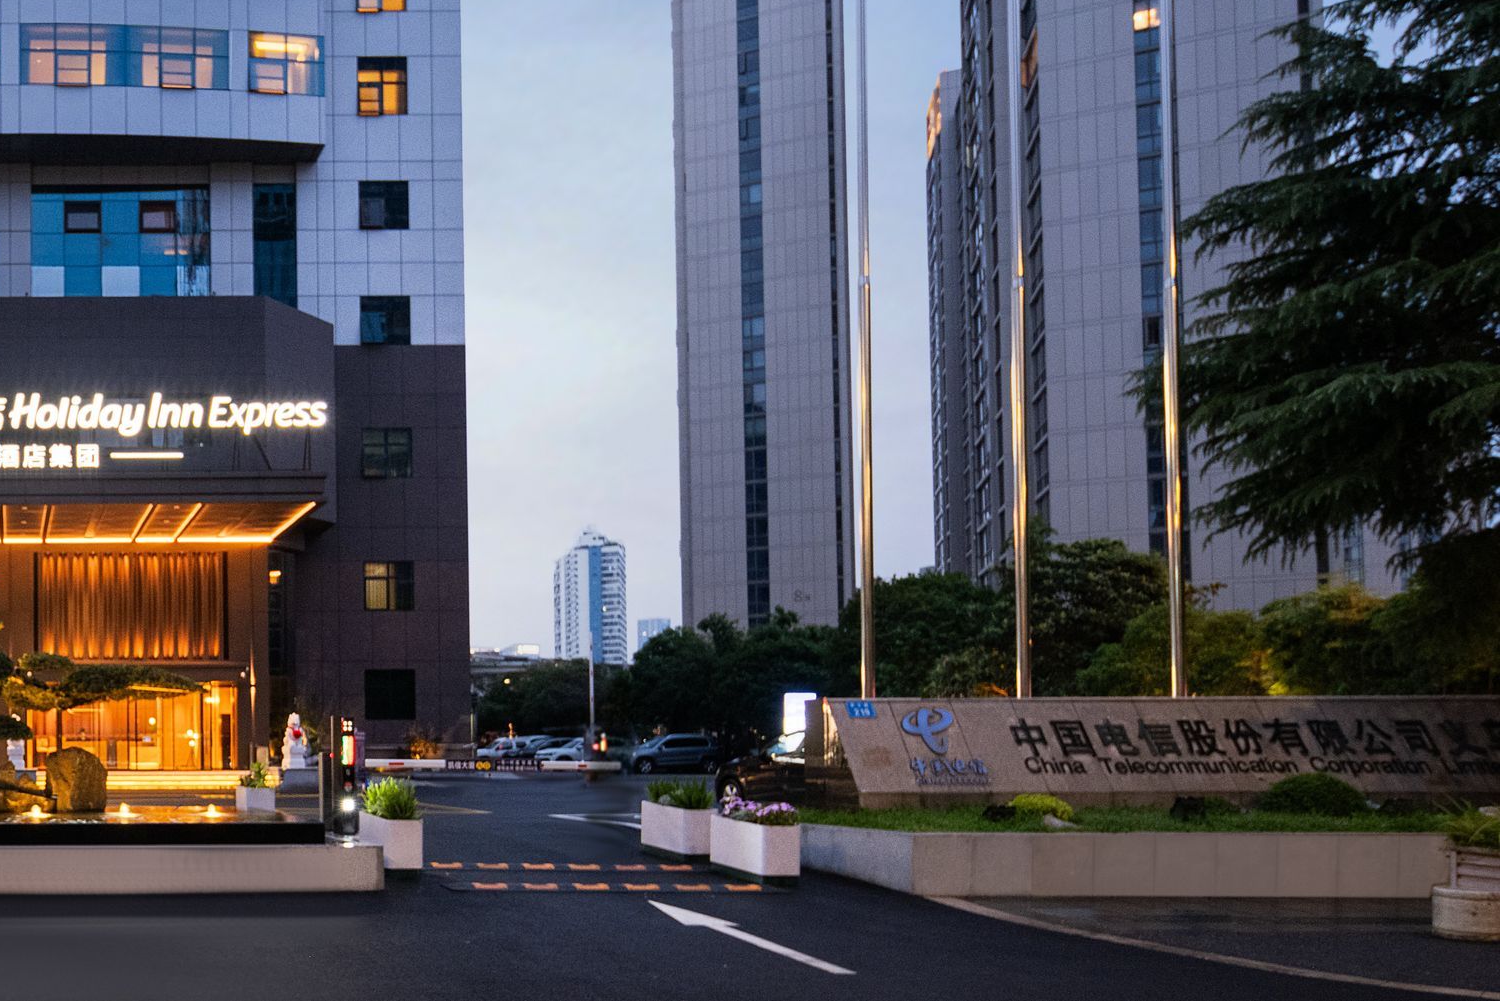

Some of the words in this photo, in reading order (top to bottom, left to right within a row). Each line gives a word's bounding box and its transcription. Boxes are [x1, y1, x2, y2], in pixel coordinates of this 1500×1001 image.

[9, 392, 145, 437] Holiday
[147, 392, 205, 429] Inn
[207, 395, 329, 437] Express
[1023, 756, 1087, 776] China
[1100, 756, 1301, 776] Telecommunication
[1310, 756, 1433, 777] Corporation
